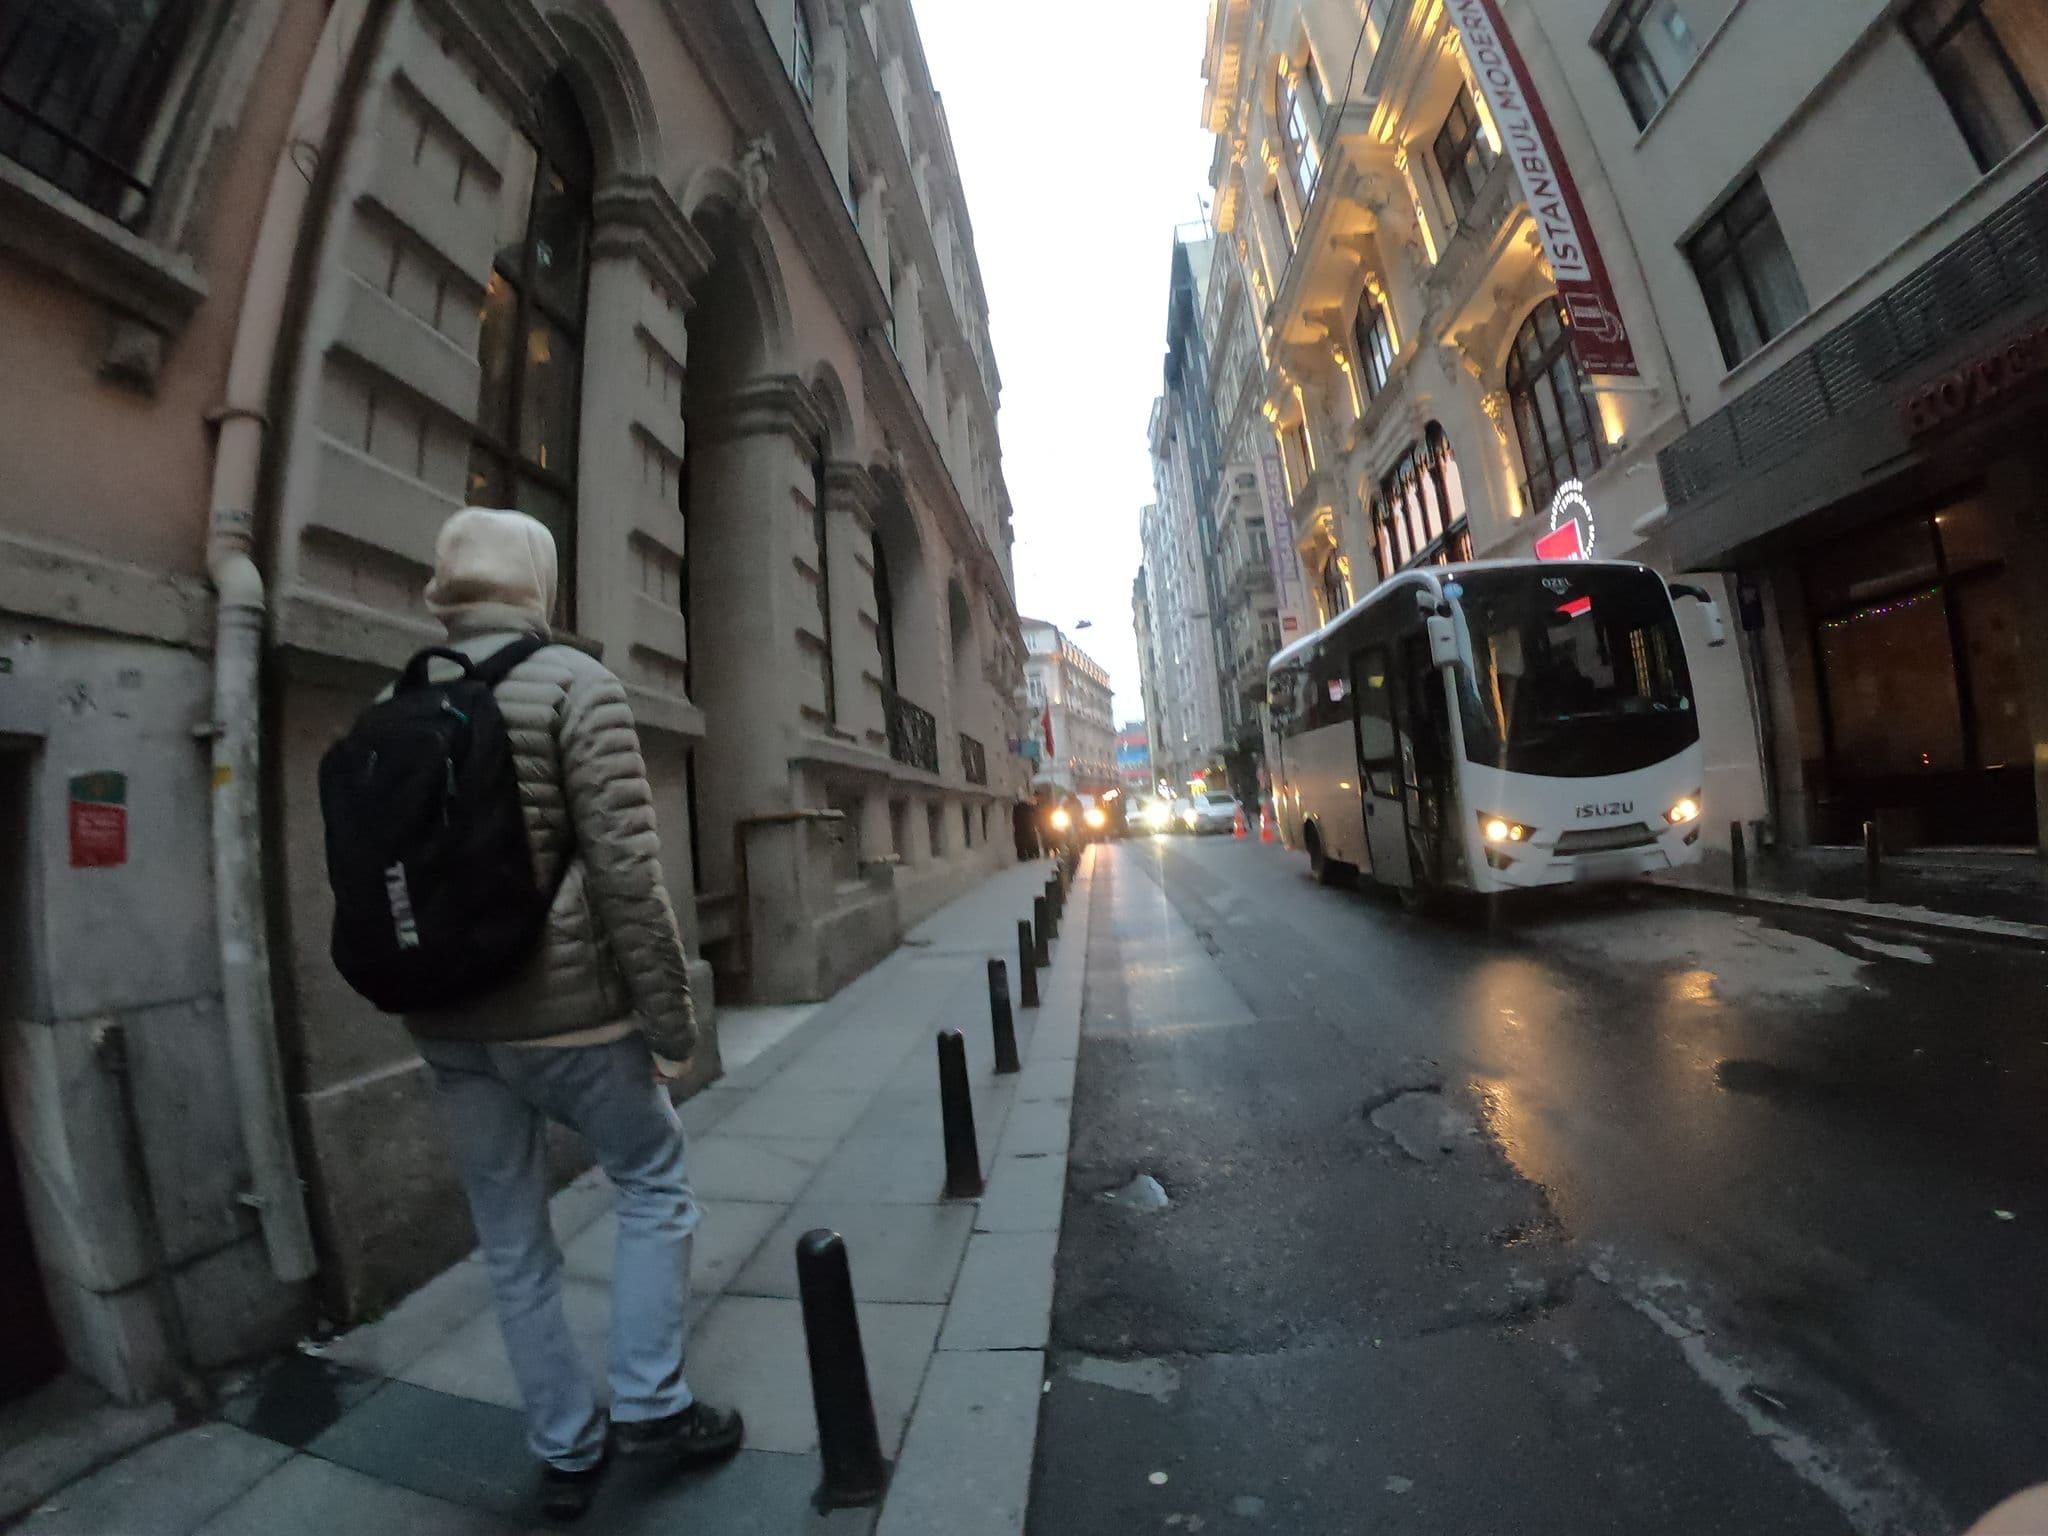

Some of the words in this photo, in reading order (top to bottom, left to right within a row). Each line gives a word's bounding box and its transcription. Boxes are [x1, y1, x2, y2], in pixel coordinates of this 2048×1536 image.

[1457, 0, 1521, 112] MODERN
[1510, 116, 1583, 273] İSTANBUL
[1576, 801, 1634, 818] ISUZU
